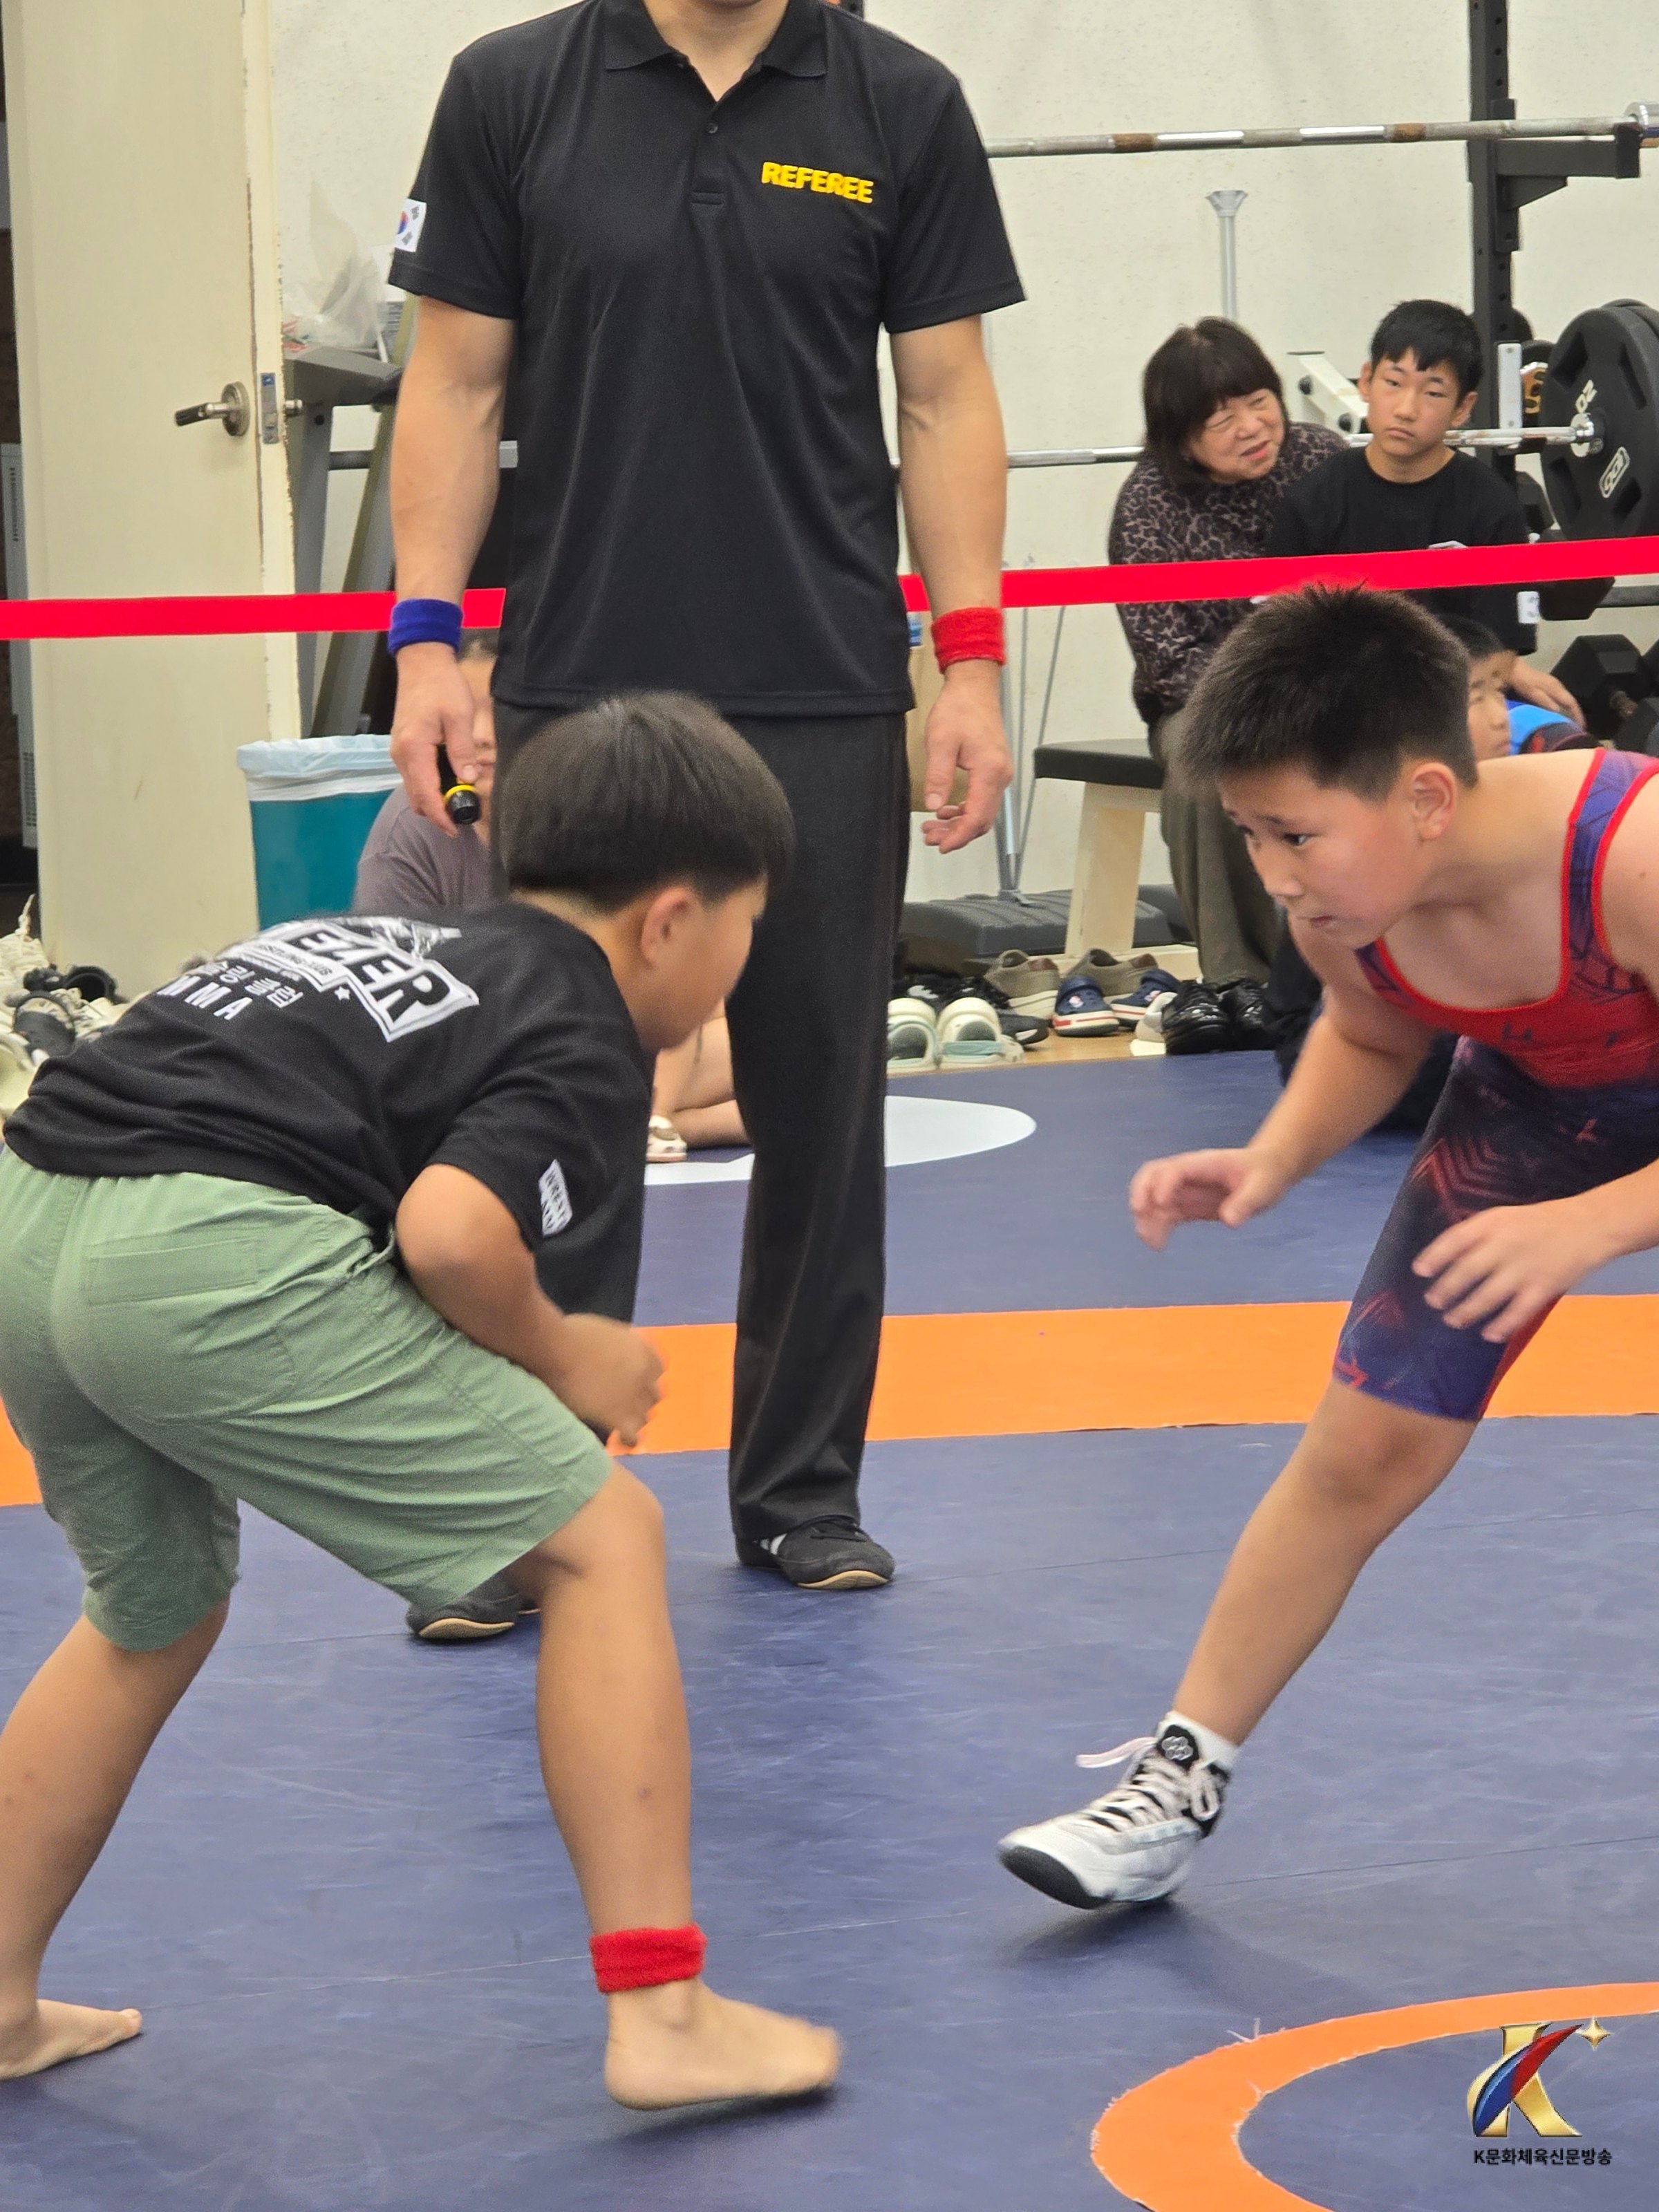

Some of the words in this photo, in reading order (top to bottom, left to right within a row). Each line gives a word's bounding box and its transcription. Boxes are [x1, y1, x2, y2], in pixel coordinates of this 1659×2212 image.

[762, 162, 874, 203] REFEREE
[156, 975, 253, 1020] MMA
[285, 929, 451, 1024] EZER
